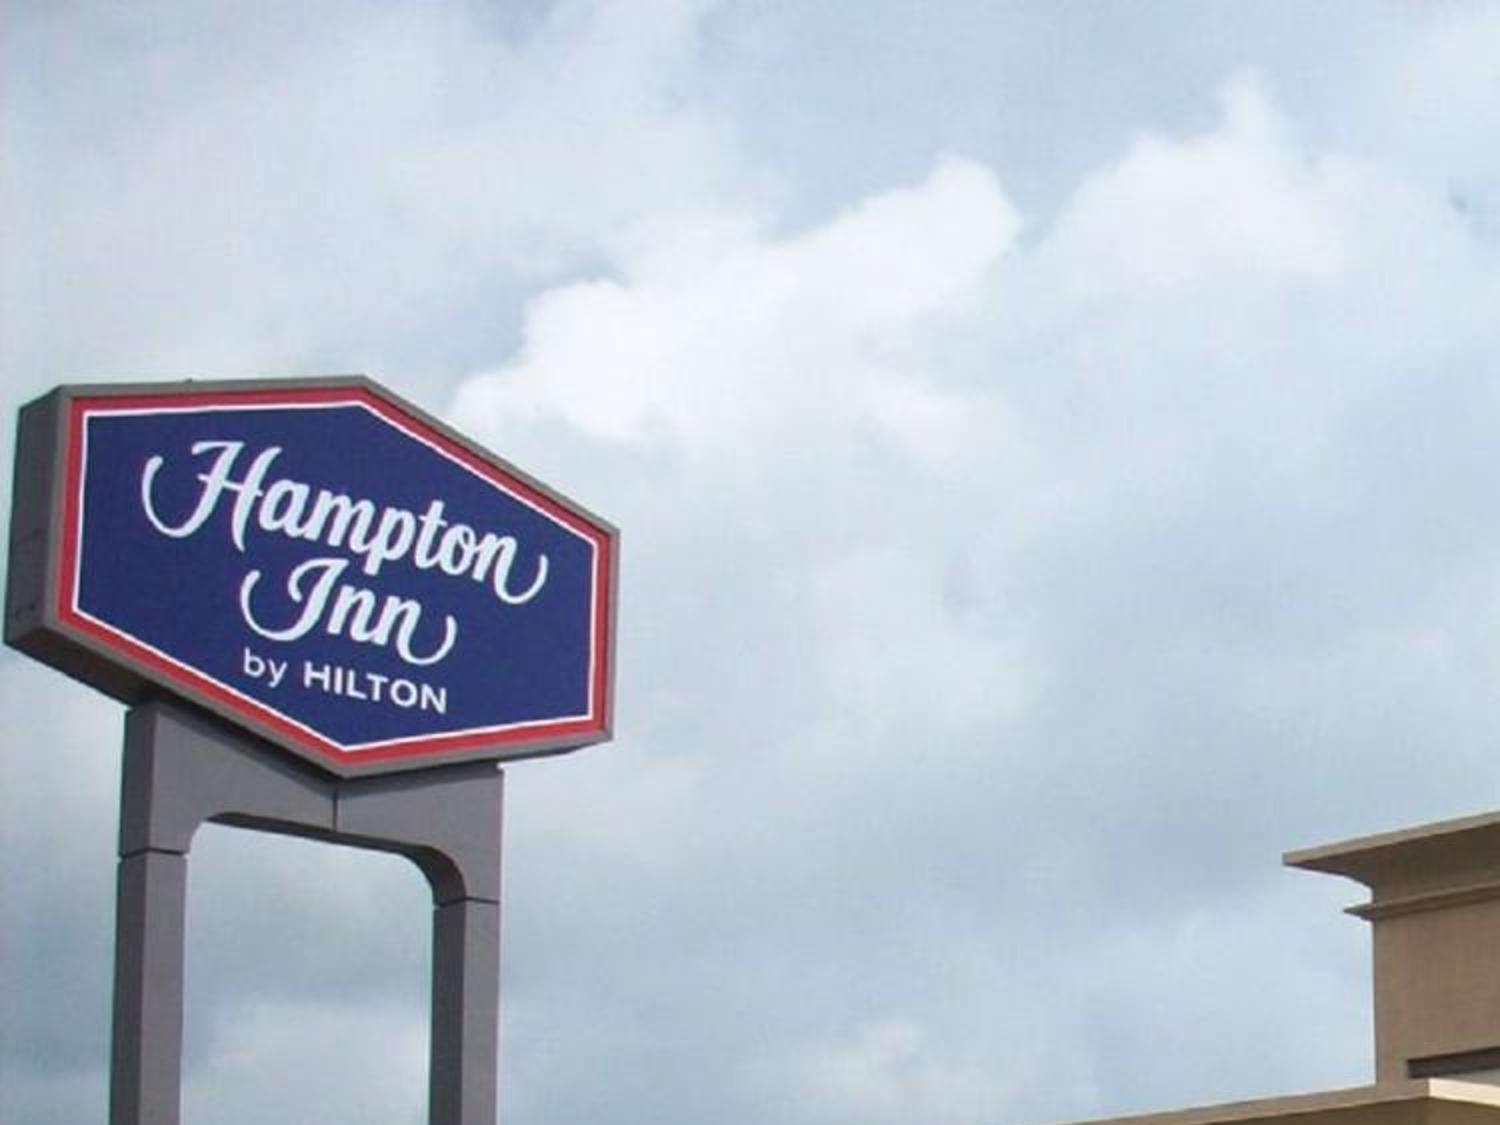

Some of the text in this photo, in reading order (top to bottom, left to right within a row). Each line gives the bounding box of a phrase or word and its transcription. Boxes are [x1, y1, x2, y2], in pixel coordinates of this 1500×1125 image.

[141, 440, 548, 604] Hampton
[240, 557, 458, 666] Inn
[244, 648, 448, 715] by HILTON
